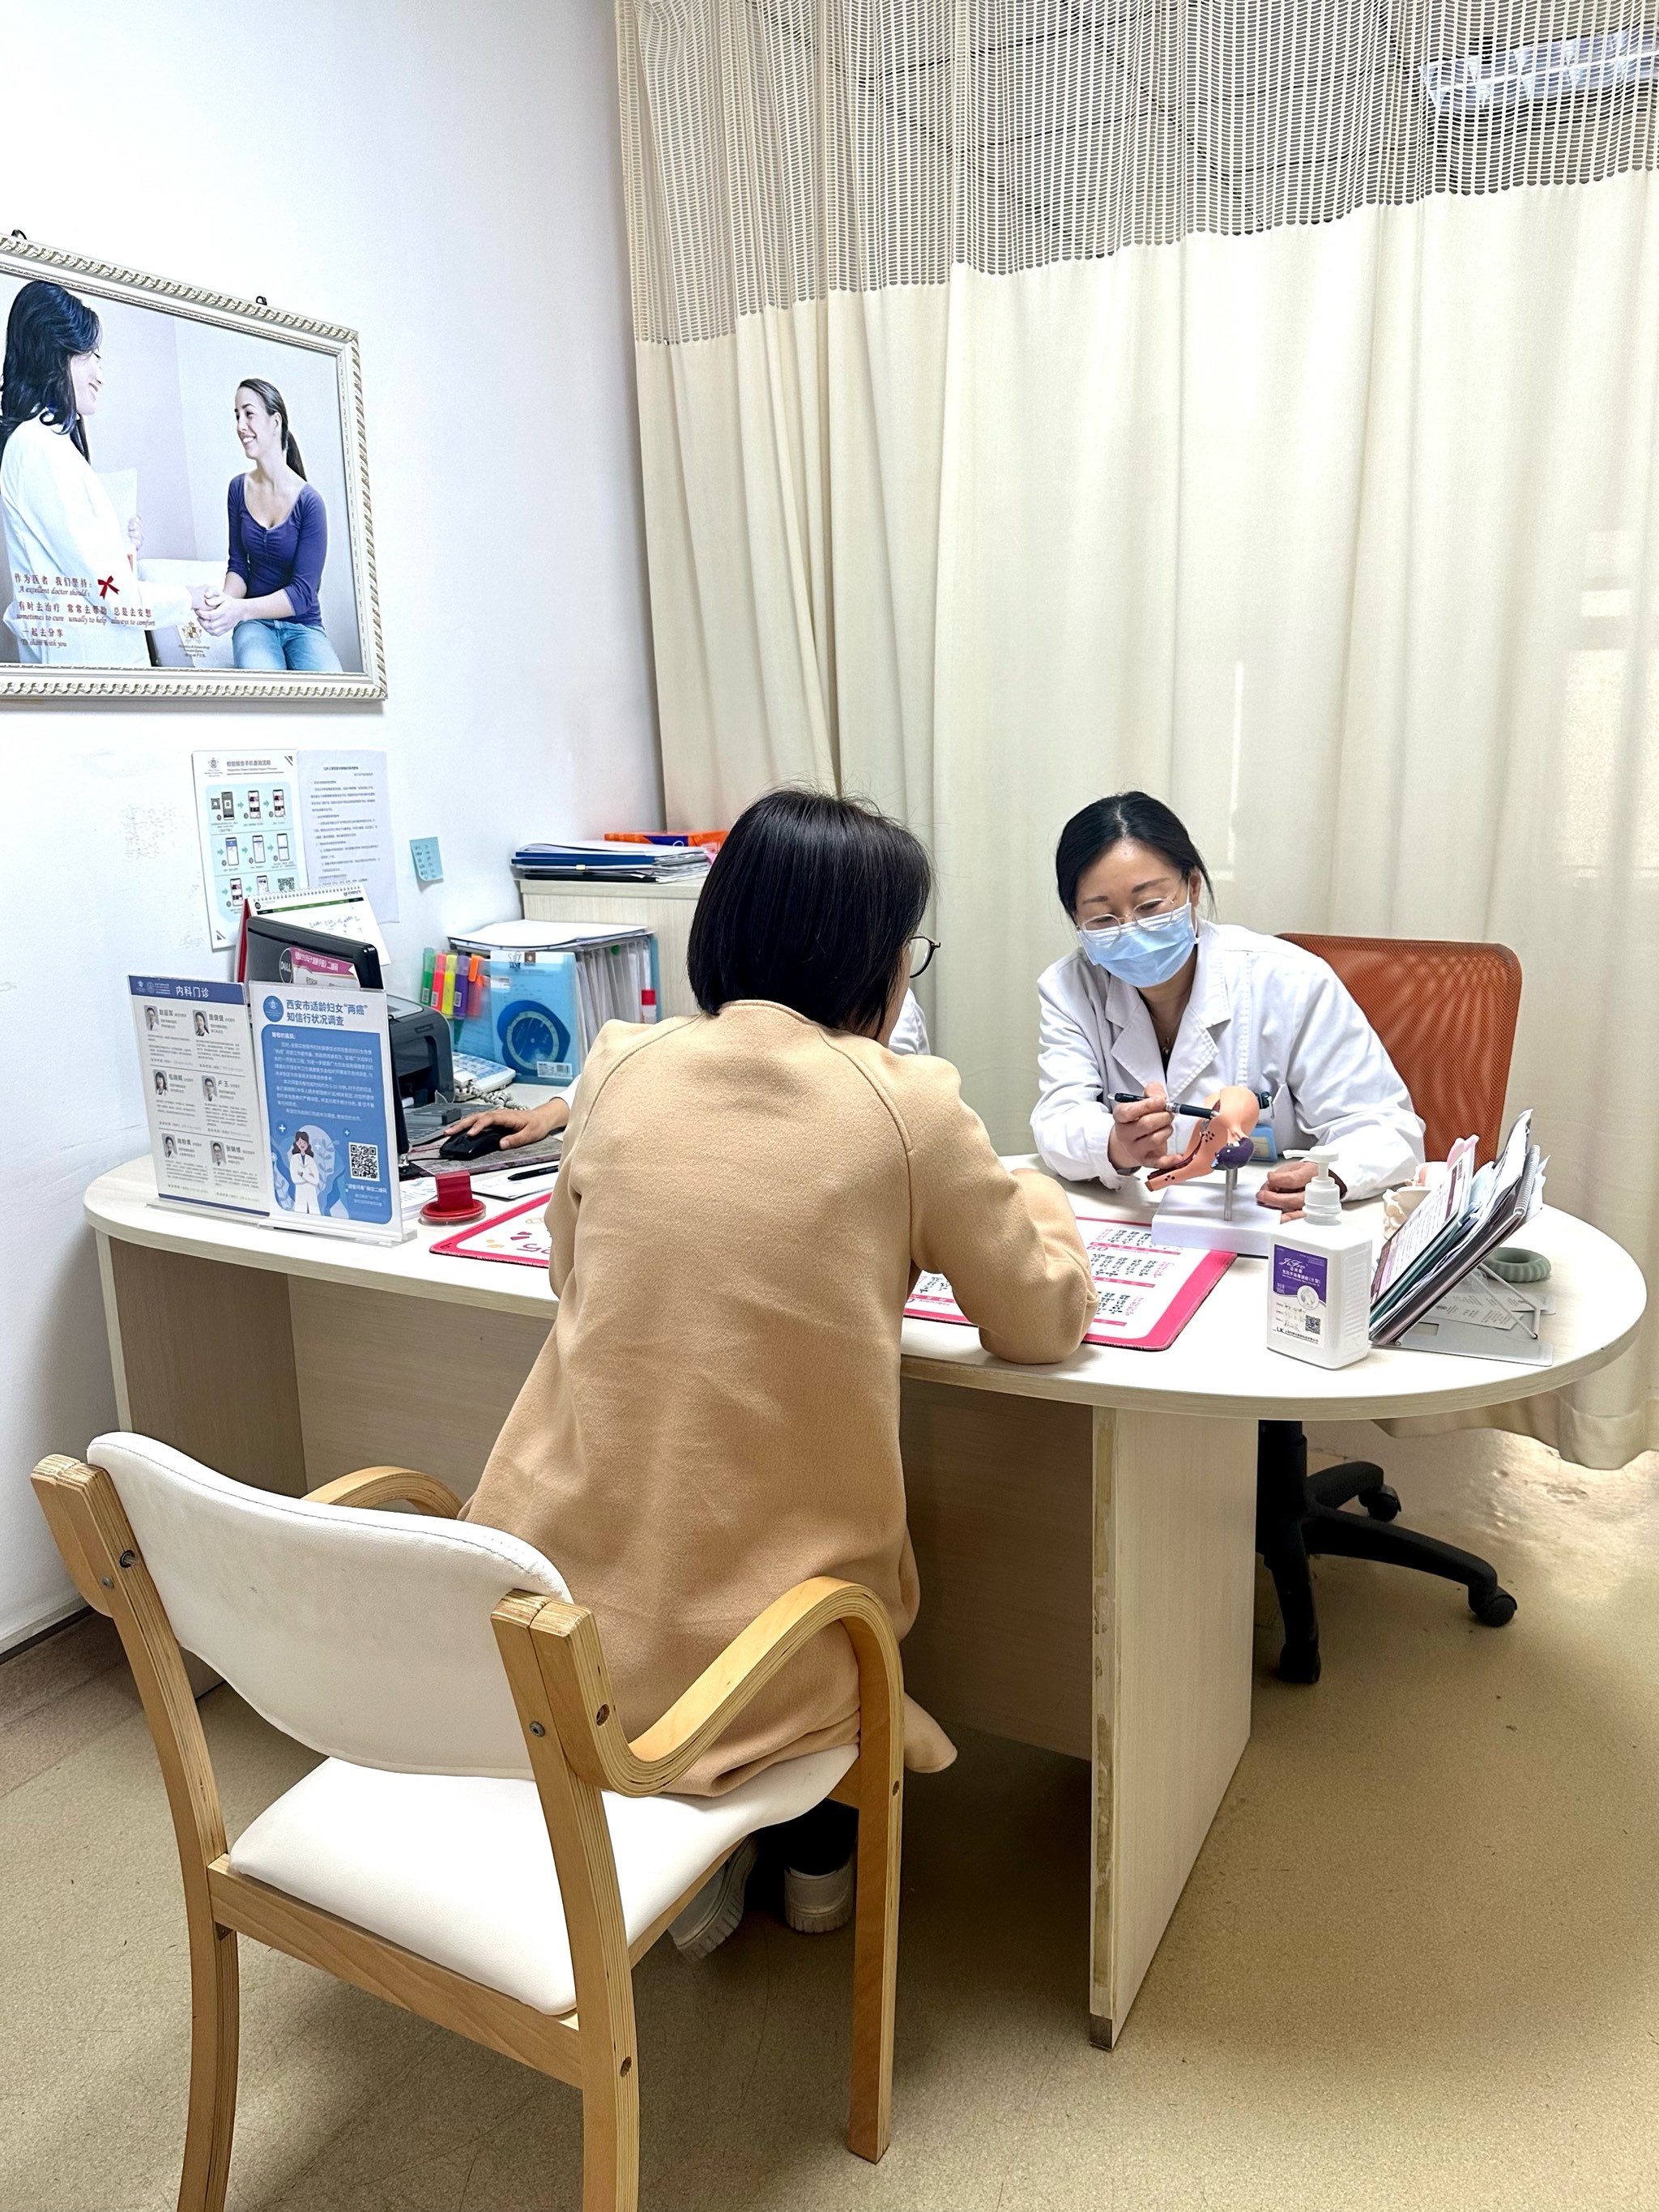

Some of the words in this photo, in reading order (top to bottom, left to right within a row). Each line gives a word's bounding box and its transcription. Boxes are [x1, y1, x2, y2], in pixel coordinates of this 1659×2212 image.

[50, 587, 68, 596] doctor
[19, 600, 59, 613] 有时去治疗
[68, 615, 88, 625] usually
[96, 616, 107, 626] help
[136, 618, 156, 628] comfort
[280, 961, 292, 973] DELL
[175, 984, 210, 998] 内科门诊
[287, 1011, 344, 1027] 知信行状况调查
